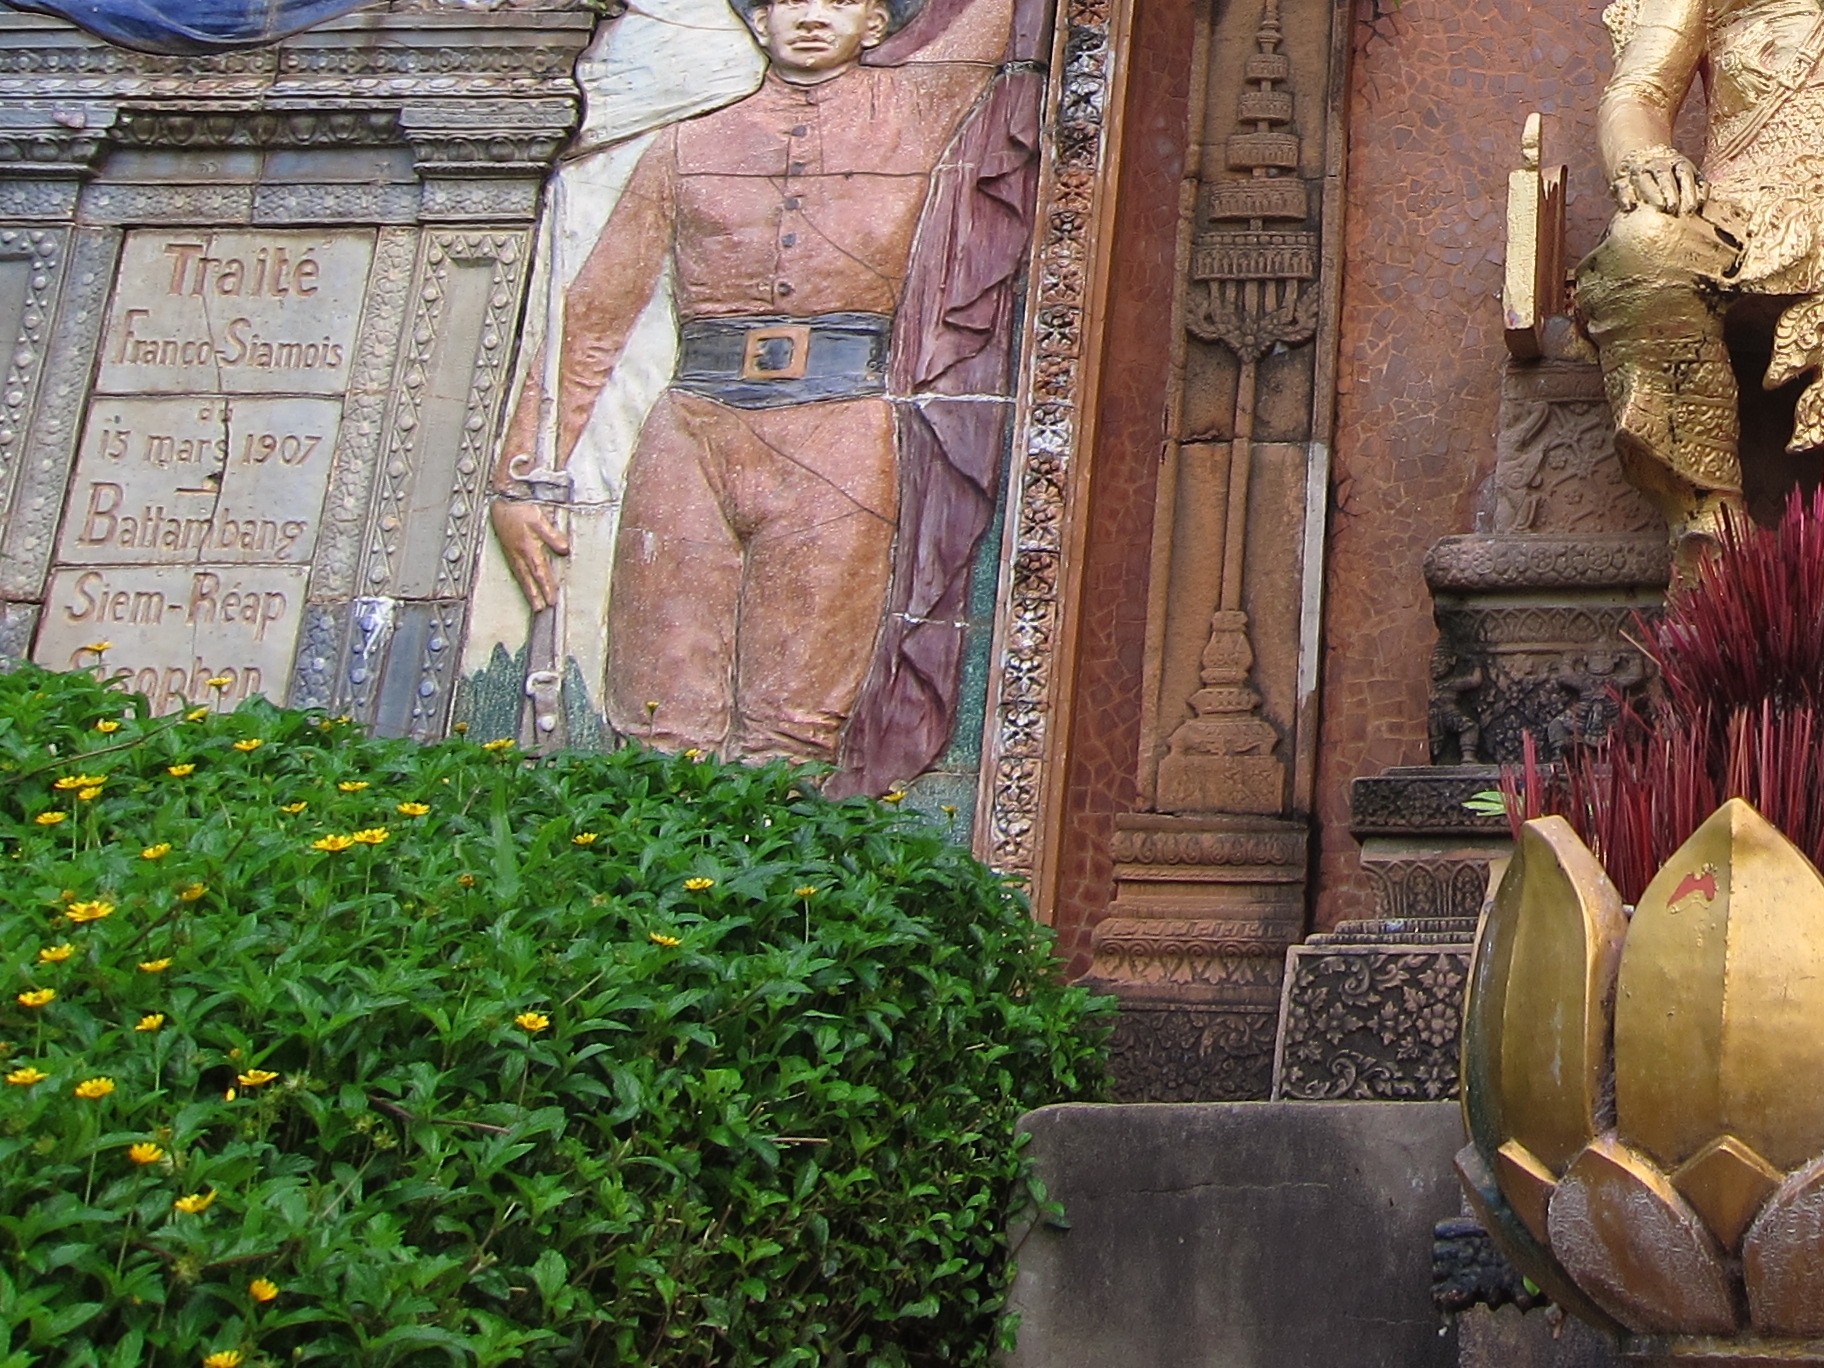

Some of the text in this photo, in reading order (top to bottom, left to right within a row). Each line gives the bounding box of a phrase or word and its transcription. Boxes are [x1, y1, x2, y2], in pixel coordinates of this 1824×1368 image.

[164, 243, 320, 297] Traité
[113, 309, 344, 369] Franco-Siamois
[102, 430, 322, 465] 15 mars 1907
[77, 482, 308, 560] Battambang
[64, 571, 287, 643] Siem-Réap
